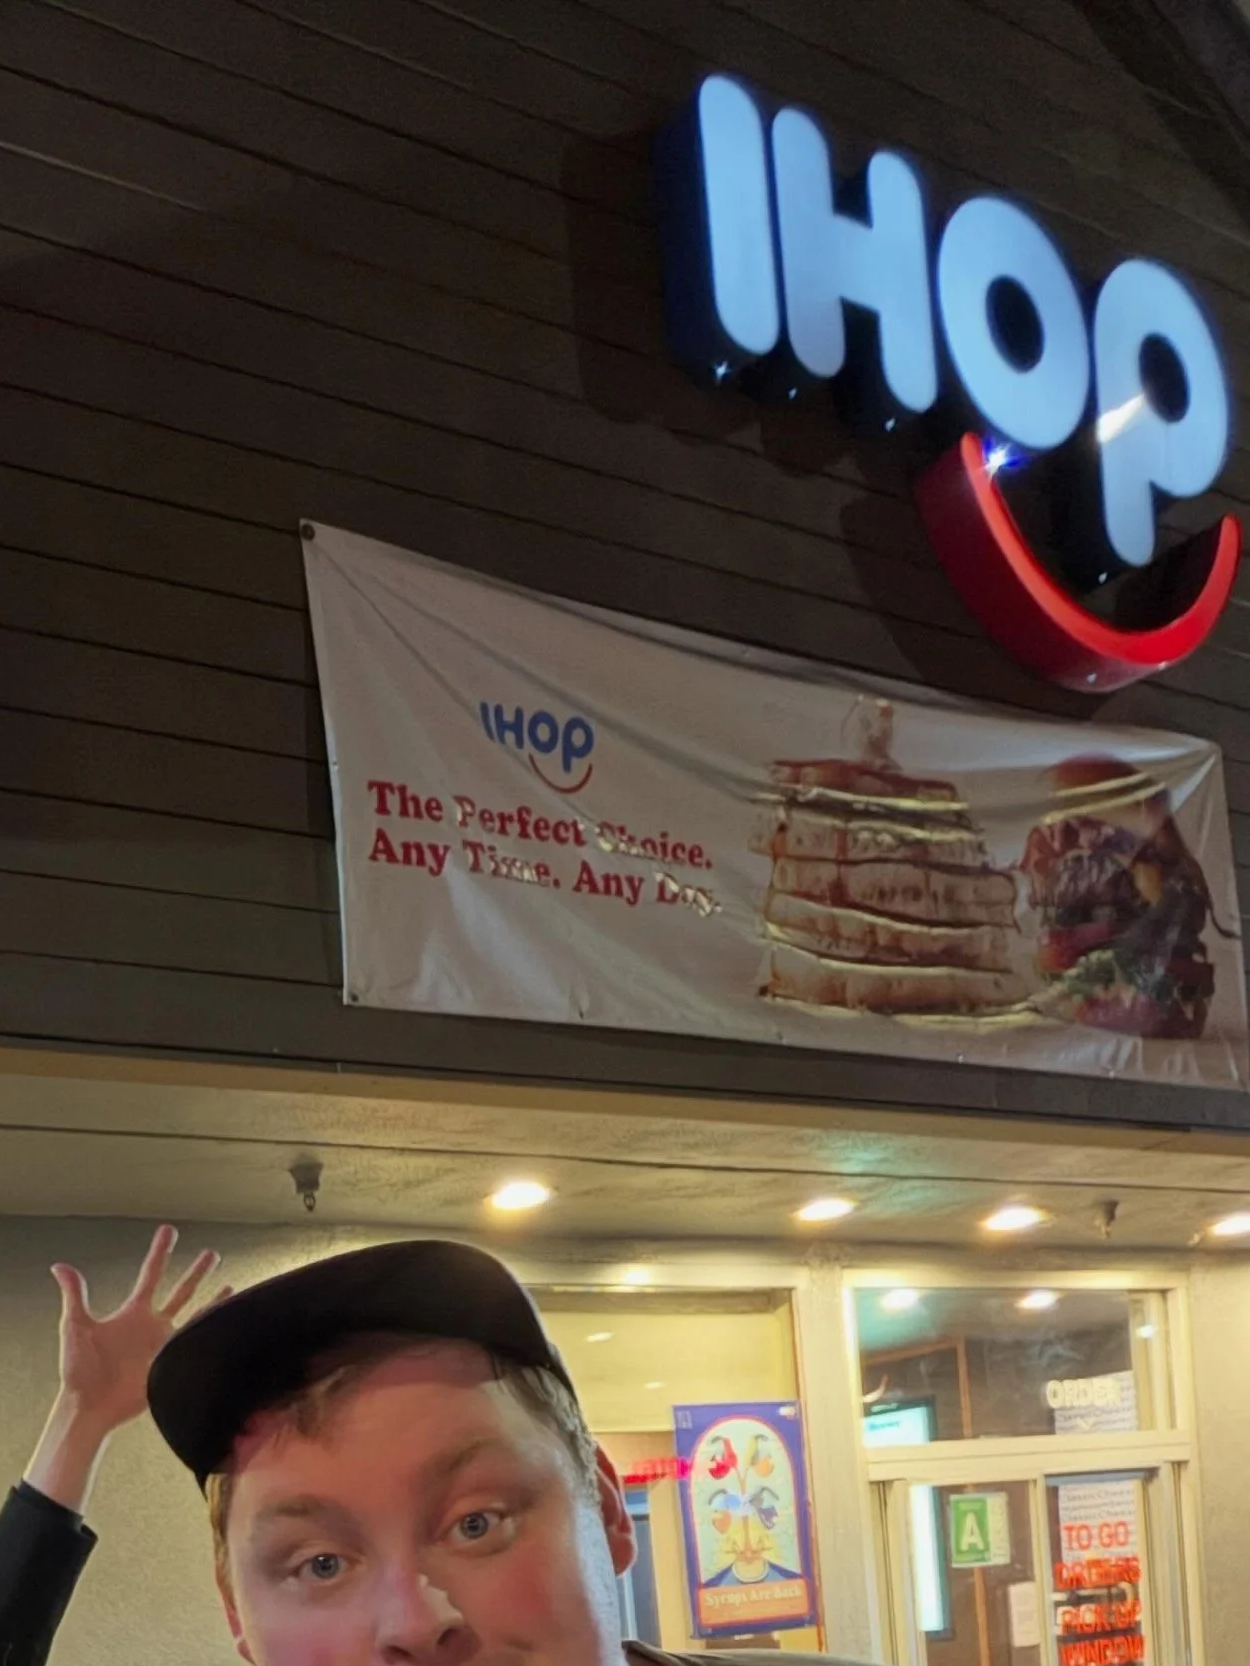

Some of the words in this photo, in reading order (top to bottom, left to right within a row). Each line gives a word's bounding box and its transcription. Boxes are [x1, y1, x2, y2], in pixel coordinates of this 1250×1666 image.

[699, 73, 1229, 567] IHOP
[479, 701, 595, 774] IHOP
[367, 779, 444, 822] The
[452, 794, 587, 847] Perfect
[596, 820, 714, 870] Choice.
[368, 827, 452, 878] Any
[461, 838, 561, 889] Time.
[572, 859, 645, 907] Any
[959, 1511, 985, 1552] A
[1062, 1522, 1093, 1552] TO
[1097, 1520, 1130, 1548] GO
[1053, 1555, 1142, 1591] ORDERS
